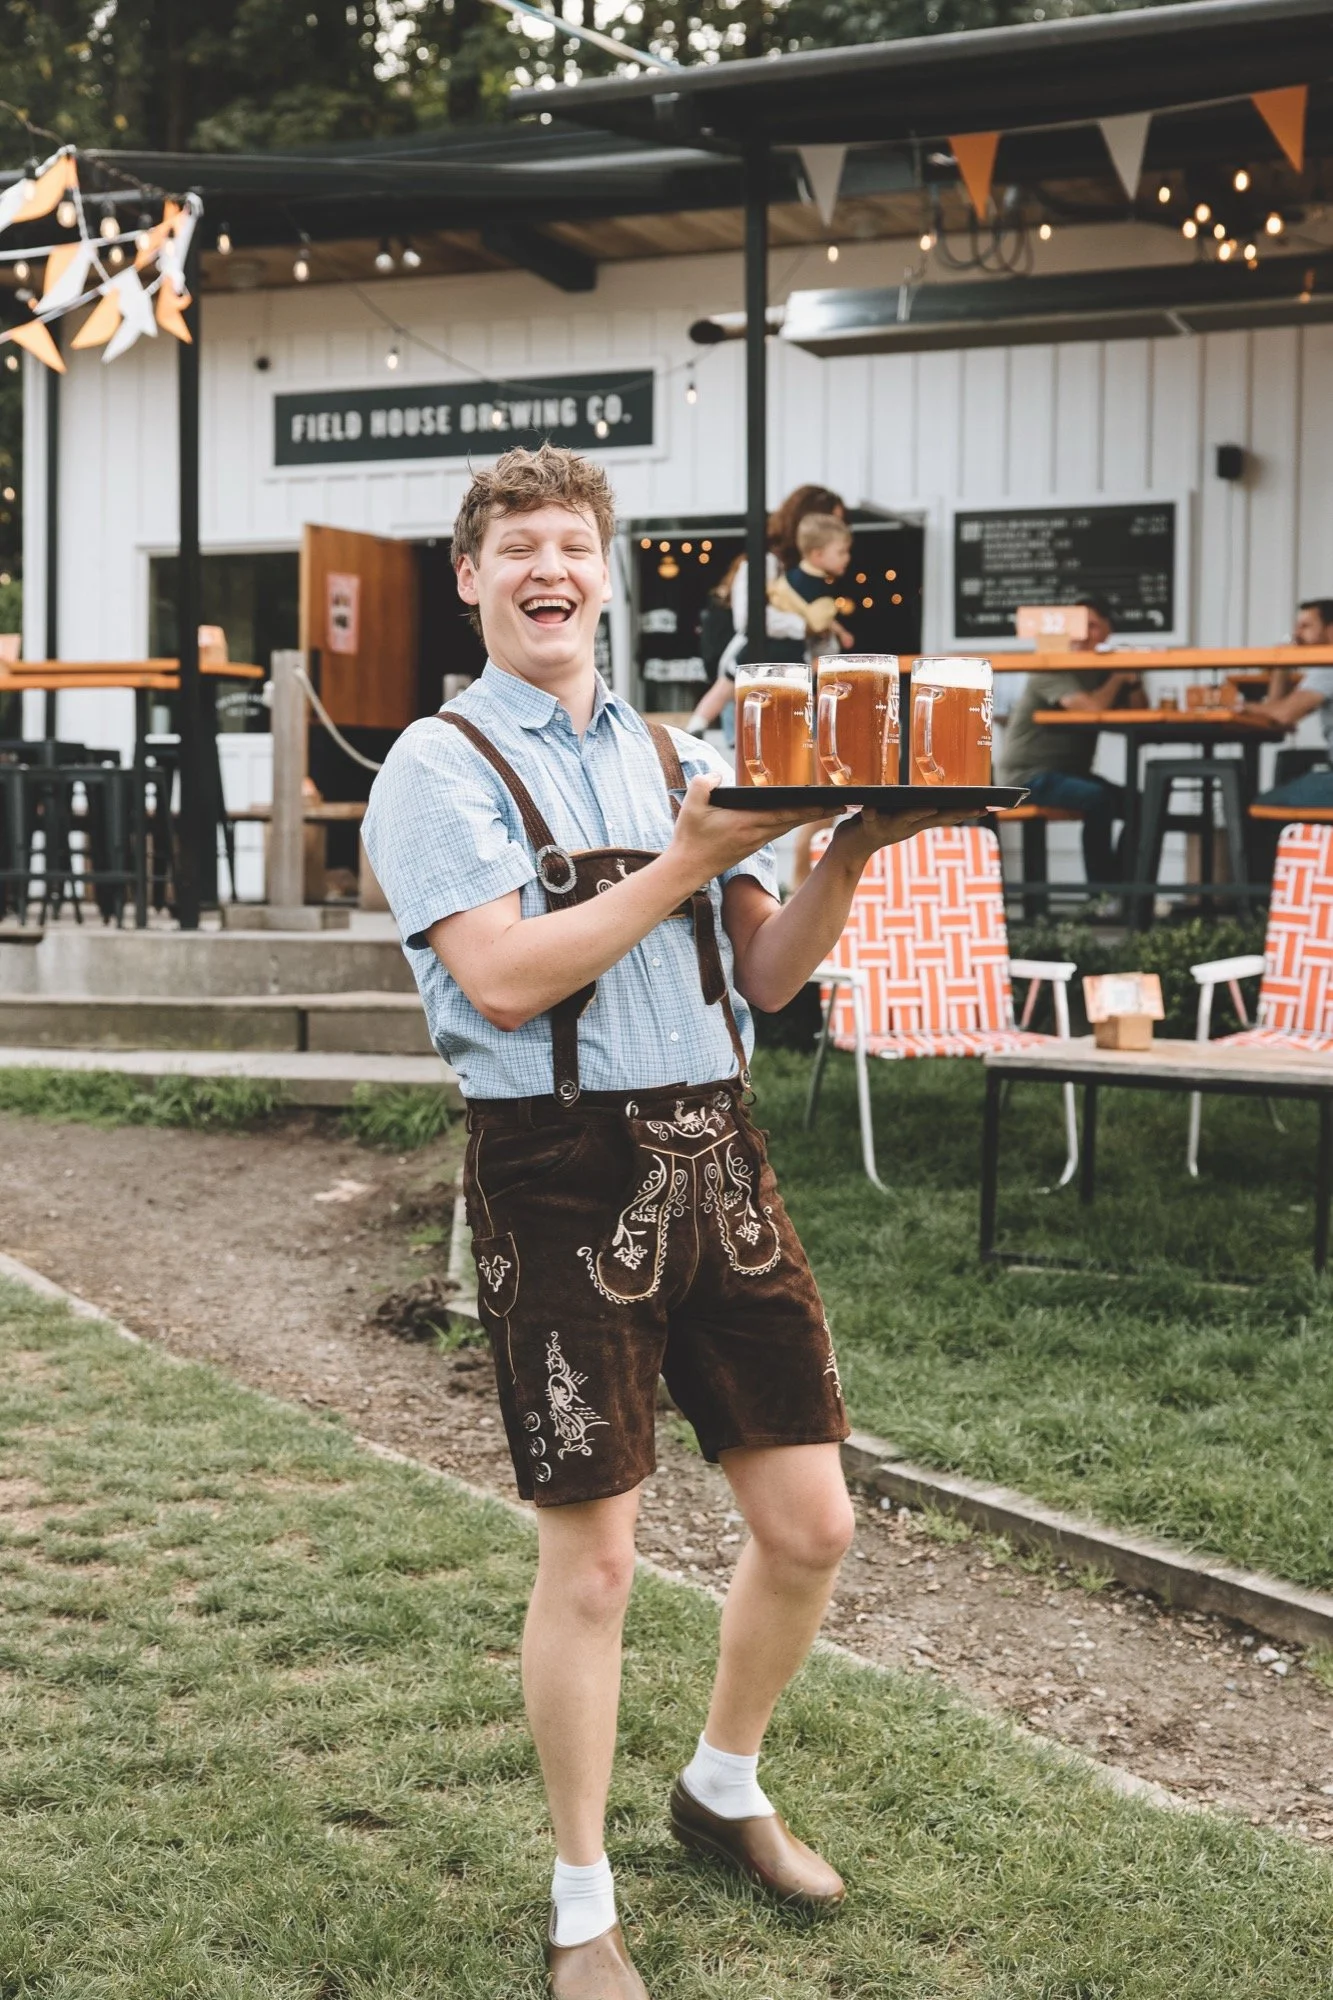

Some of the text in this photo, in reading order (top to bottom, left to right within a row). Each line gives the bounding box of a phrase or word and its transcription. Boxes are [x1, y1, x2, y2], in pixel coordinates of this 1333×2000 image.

[291, 394, 632, 443] FIELD HOUSE BREWING CO.
